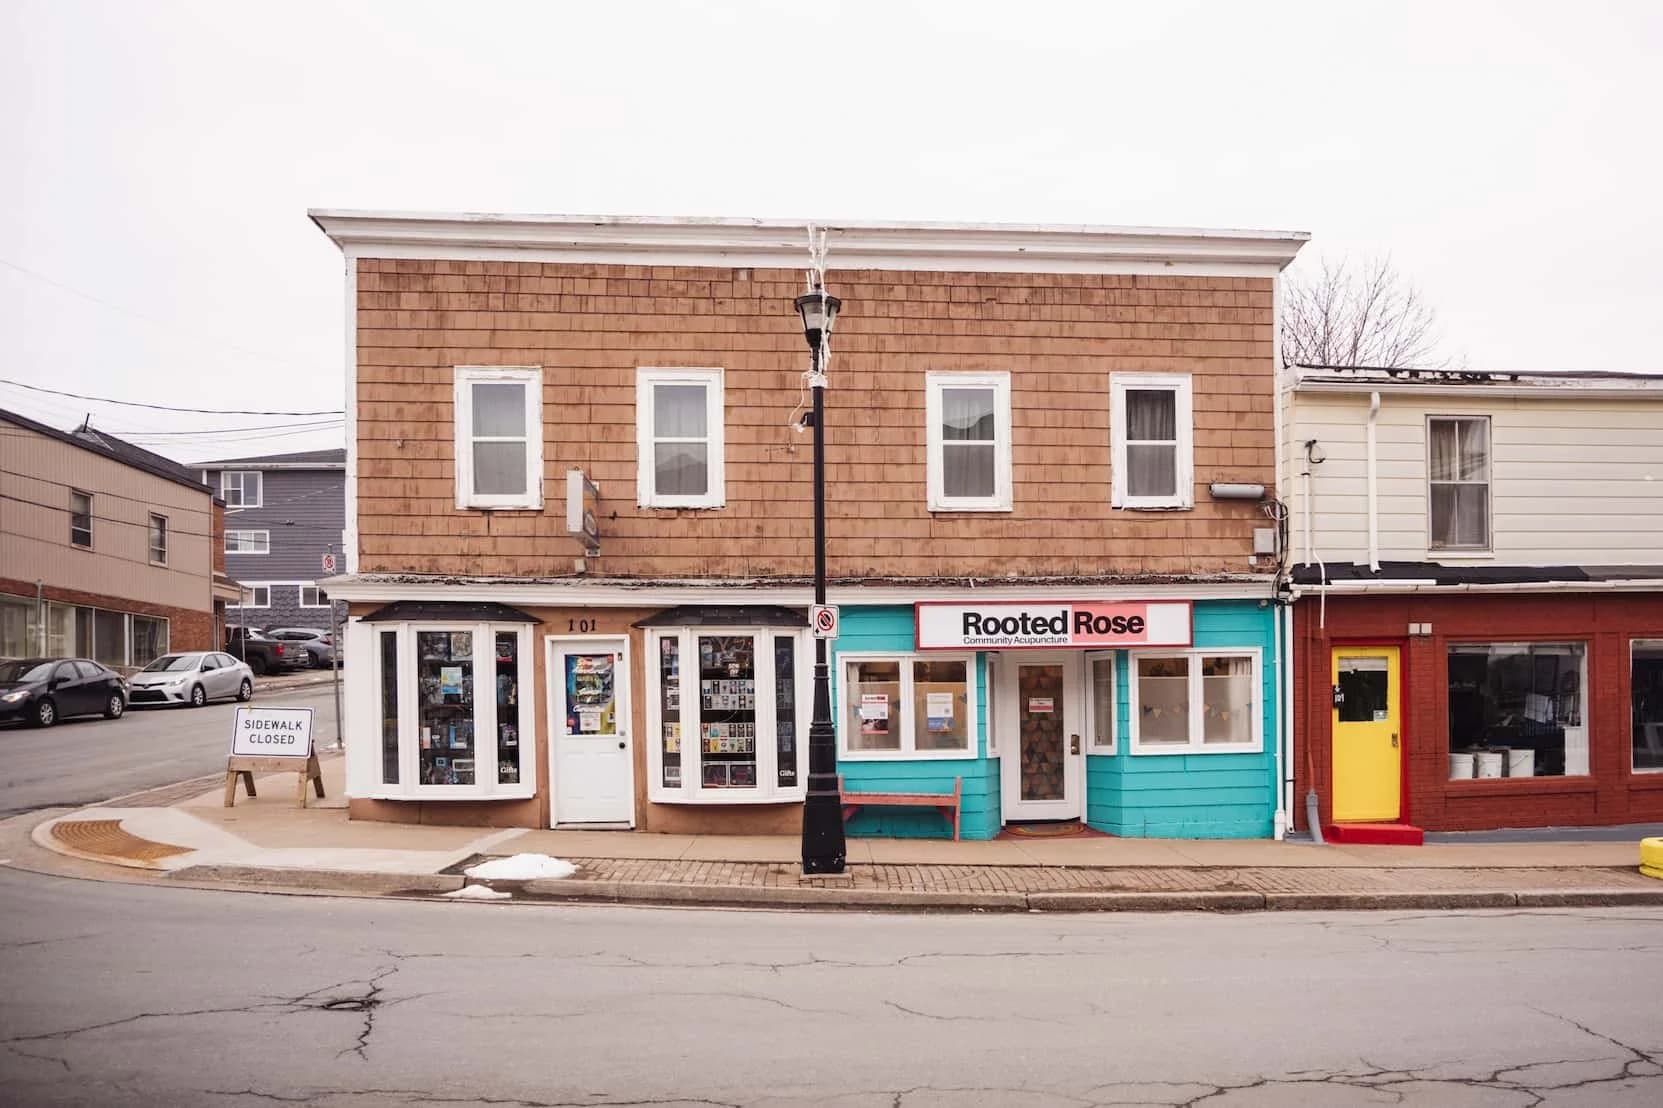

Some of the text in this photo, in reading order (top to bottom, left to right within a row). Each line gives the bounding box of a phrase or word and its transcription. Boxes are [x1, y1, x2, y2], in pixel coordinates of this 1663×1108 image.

[568, 618, 596, 633] 101
[962, 610, 1145, 635] Rooted Rose
[963, 636, 1068, 646] Community Acupuncture
[244, 719, 302, 730] SIDEWALK
[249, 734, 295, 744] CLOSED
